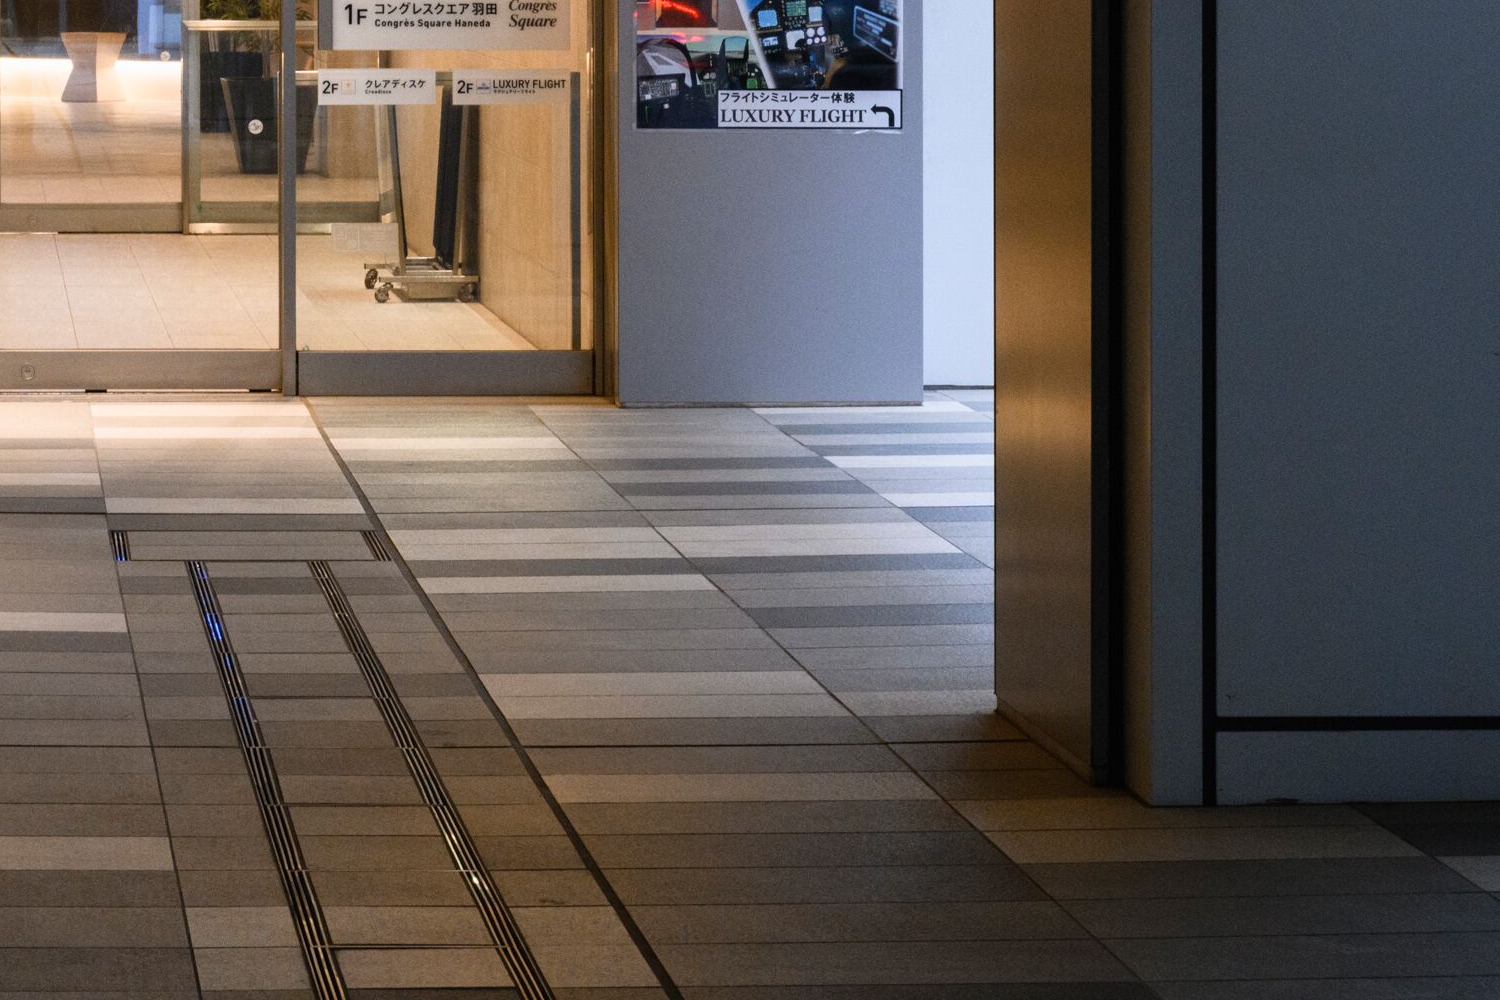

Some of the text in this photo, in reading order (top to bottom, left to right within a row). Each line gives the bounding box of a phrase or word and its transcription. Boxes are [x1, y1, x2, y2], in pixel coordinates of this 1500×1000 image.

[344, 3, 368, 25] 1F
[375, 2, 498, 16] コングレスクエア 羽田
[374, 18, 491, 29] Congrès Square Haneda
[508, 14, 558, 31] Square
[322, 80, 339, 95] 2F
[364, 79, 426, 89] クレアディスケ
[457, 80, 473, 95] 2F
[492, 79, 567, 89] LUXURY FLIGHT
[720, 91, 856, 104] フライトシミュレーター体験
[720, 109, 867, 123] LUXURY FLIGHT
